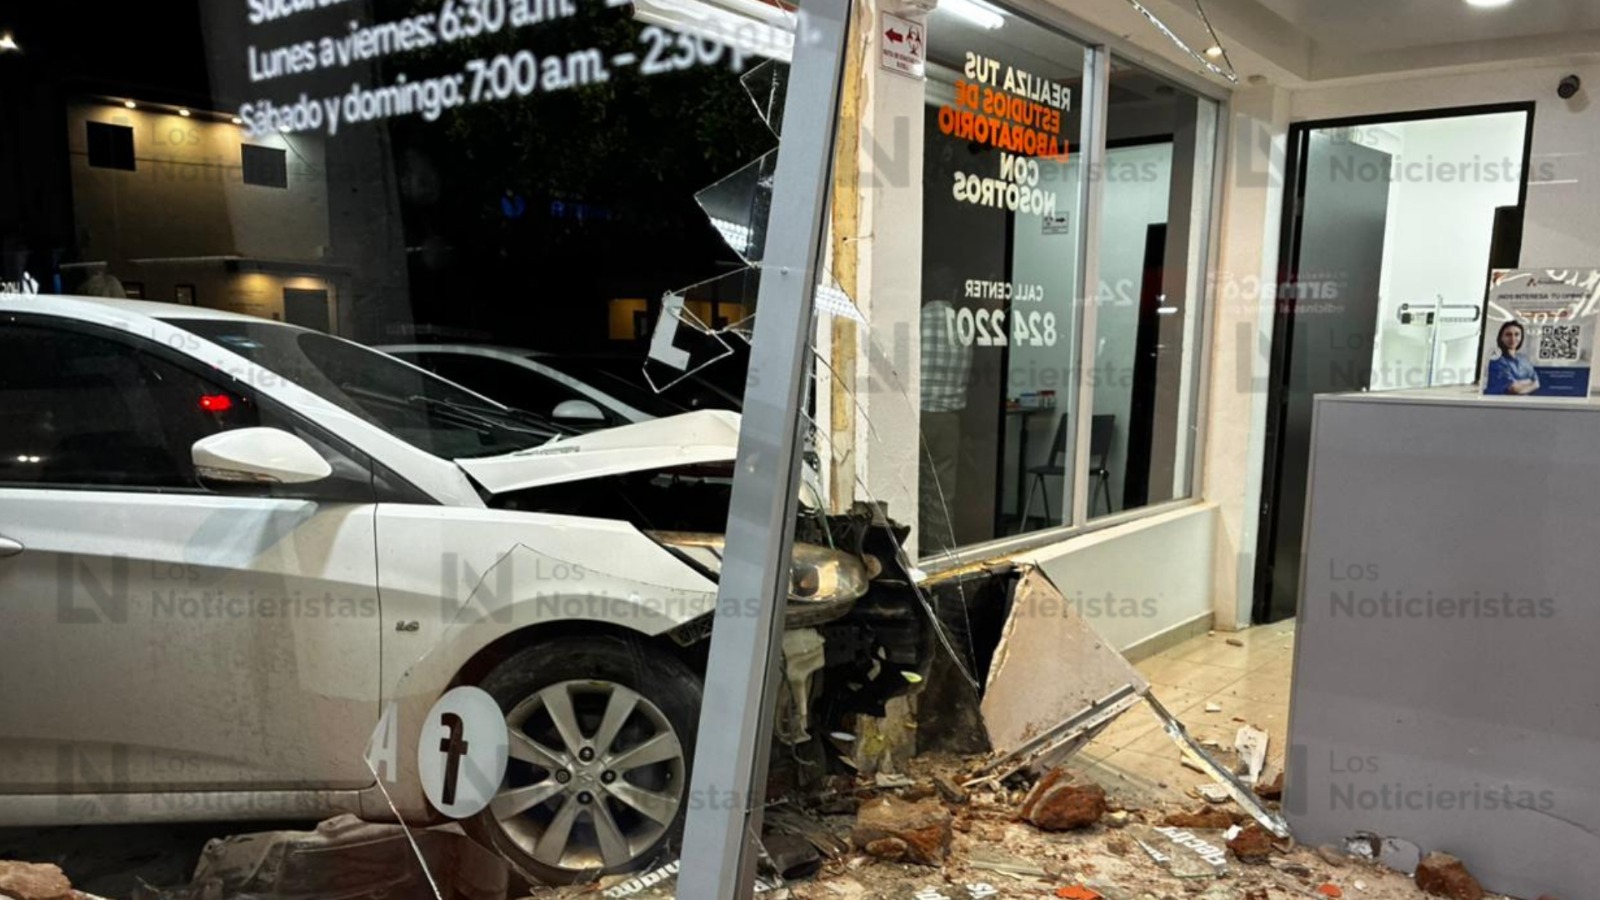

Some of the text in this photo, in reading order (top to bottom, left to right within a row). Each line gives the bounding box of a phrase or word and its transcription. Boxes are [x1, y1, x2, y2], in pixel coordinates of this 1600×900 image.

[239, 94, 323, 137] Sábado
[325, 96, 340, 135] y
[343, 73, 465, 122] domingo:
[465, 50, 537, 103] 7:00
[541, 47, 610, 91] a.m.
[639, 15, 724, 74] 2:30
[249, 41, 317, 82] Lunes
[319, 37, 335, 69] a
[333, 14, 437, 67] viernes:
[439, 0, 505, 41] 6:30
